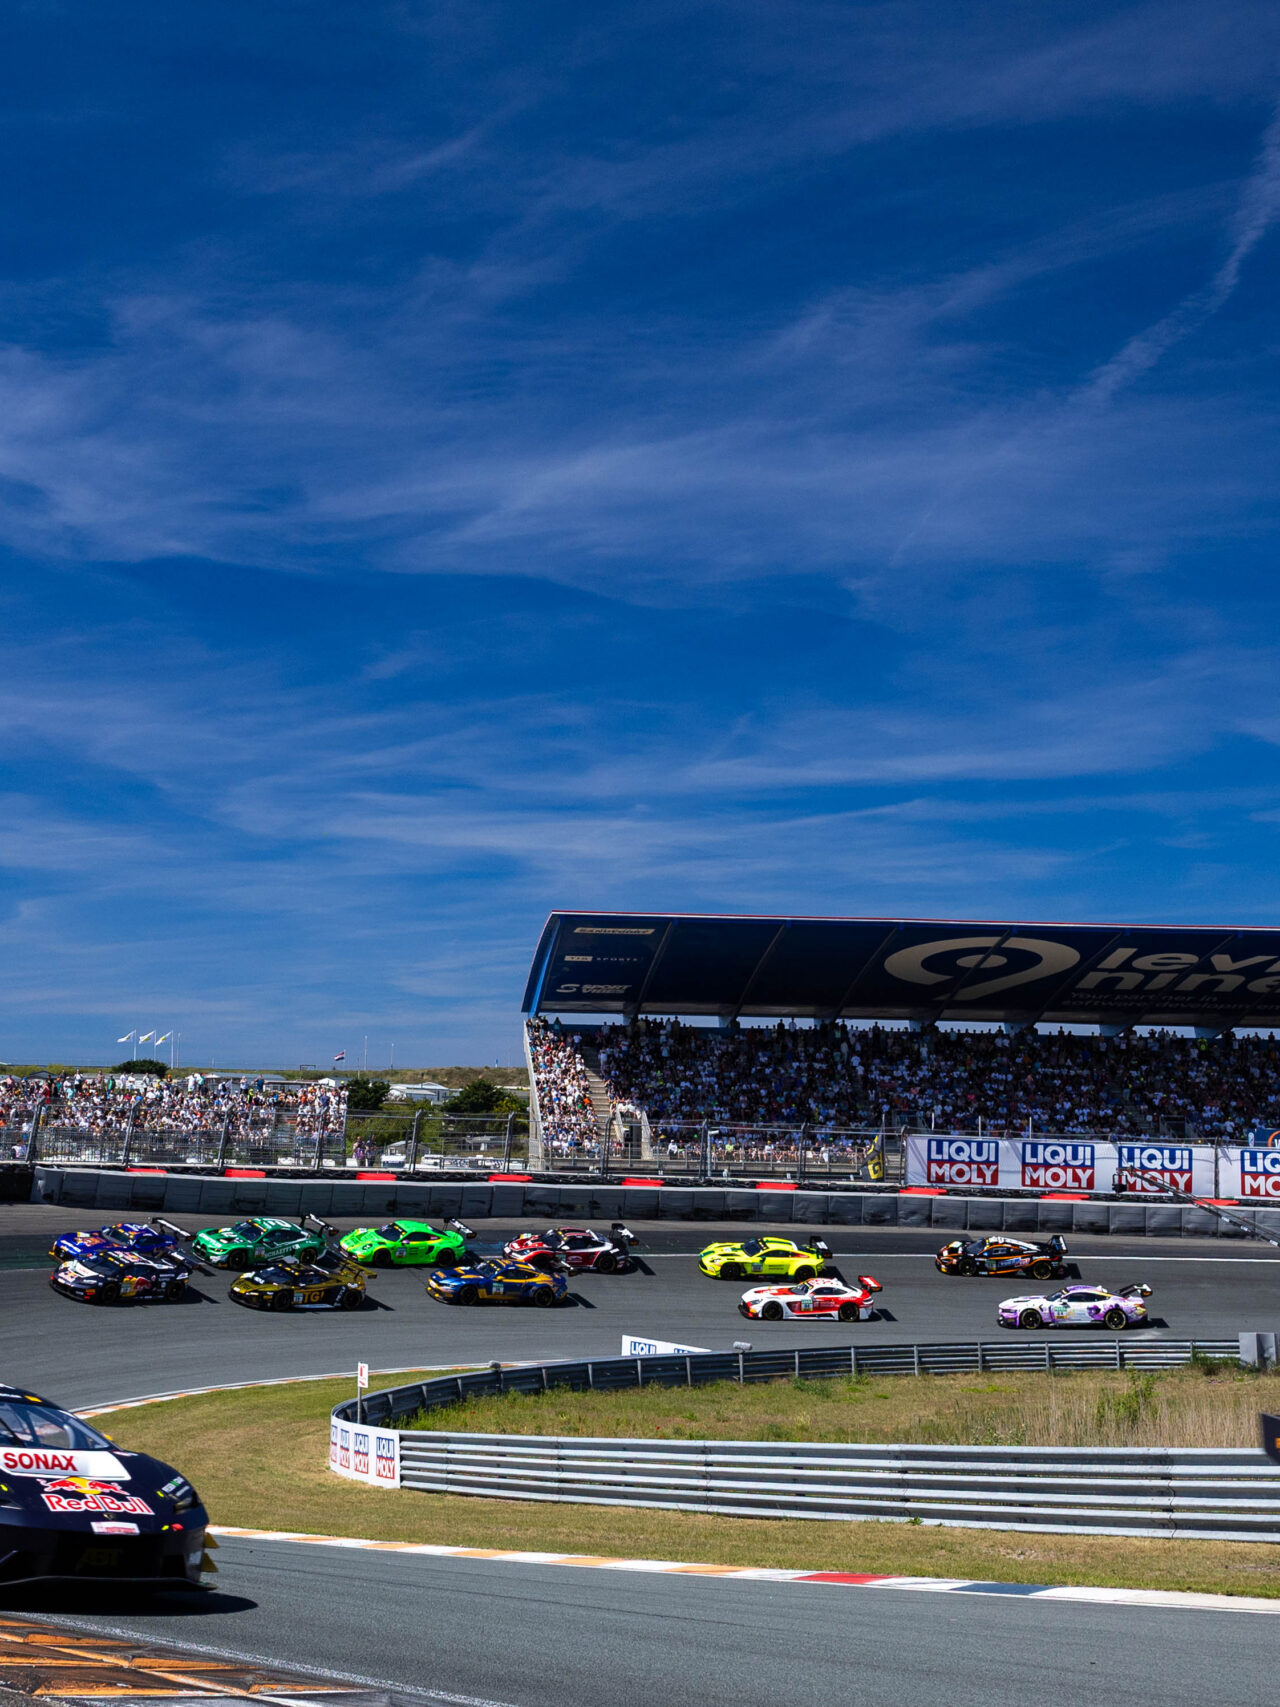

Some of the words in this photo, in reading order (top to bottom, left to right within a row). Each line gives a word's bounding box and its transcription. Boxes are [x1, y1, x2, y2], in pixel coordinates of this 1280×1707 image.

[930, 1140, 996, 1162] LIQUI
[1025, 1144, 1091, 1167] LIQUI
[1121, 1148, 1190, 1169] LIQUI
[930, 1163, 998, 1184] MOLY
[1244, 1152, 1280, 1174] LIQ
[1025, 1167, 1093, 1188] MOLY
[1245, 1175, 1280, 1196] MO
[376, 1437, 394, 1459] LIQUI
[3, 1452, 78, 1472] SONAX
[376, 1458, 395, 1479] MOLY
[41, 1493, 103, 1512] Red
[100, 1495, 155, 1515] Bull
